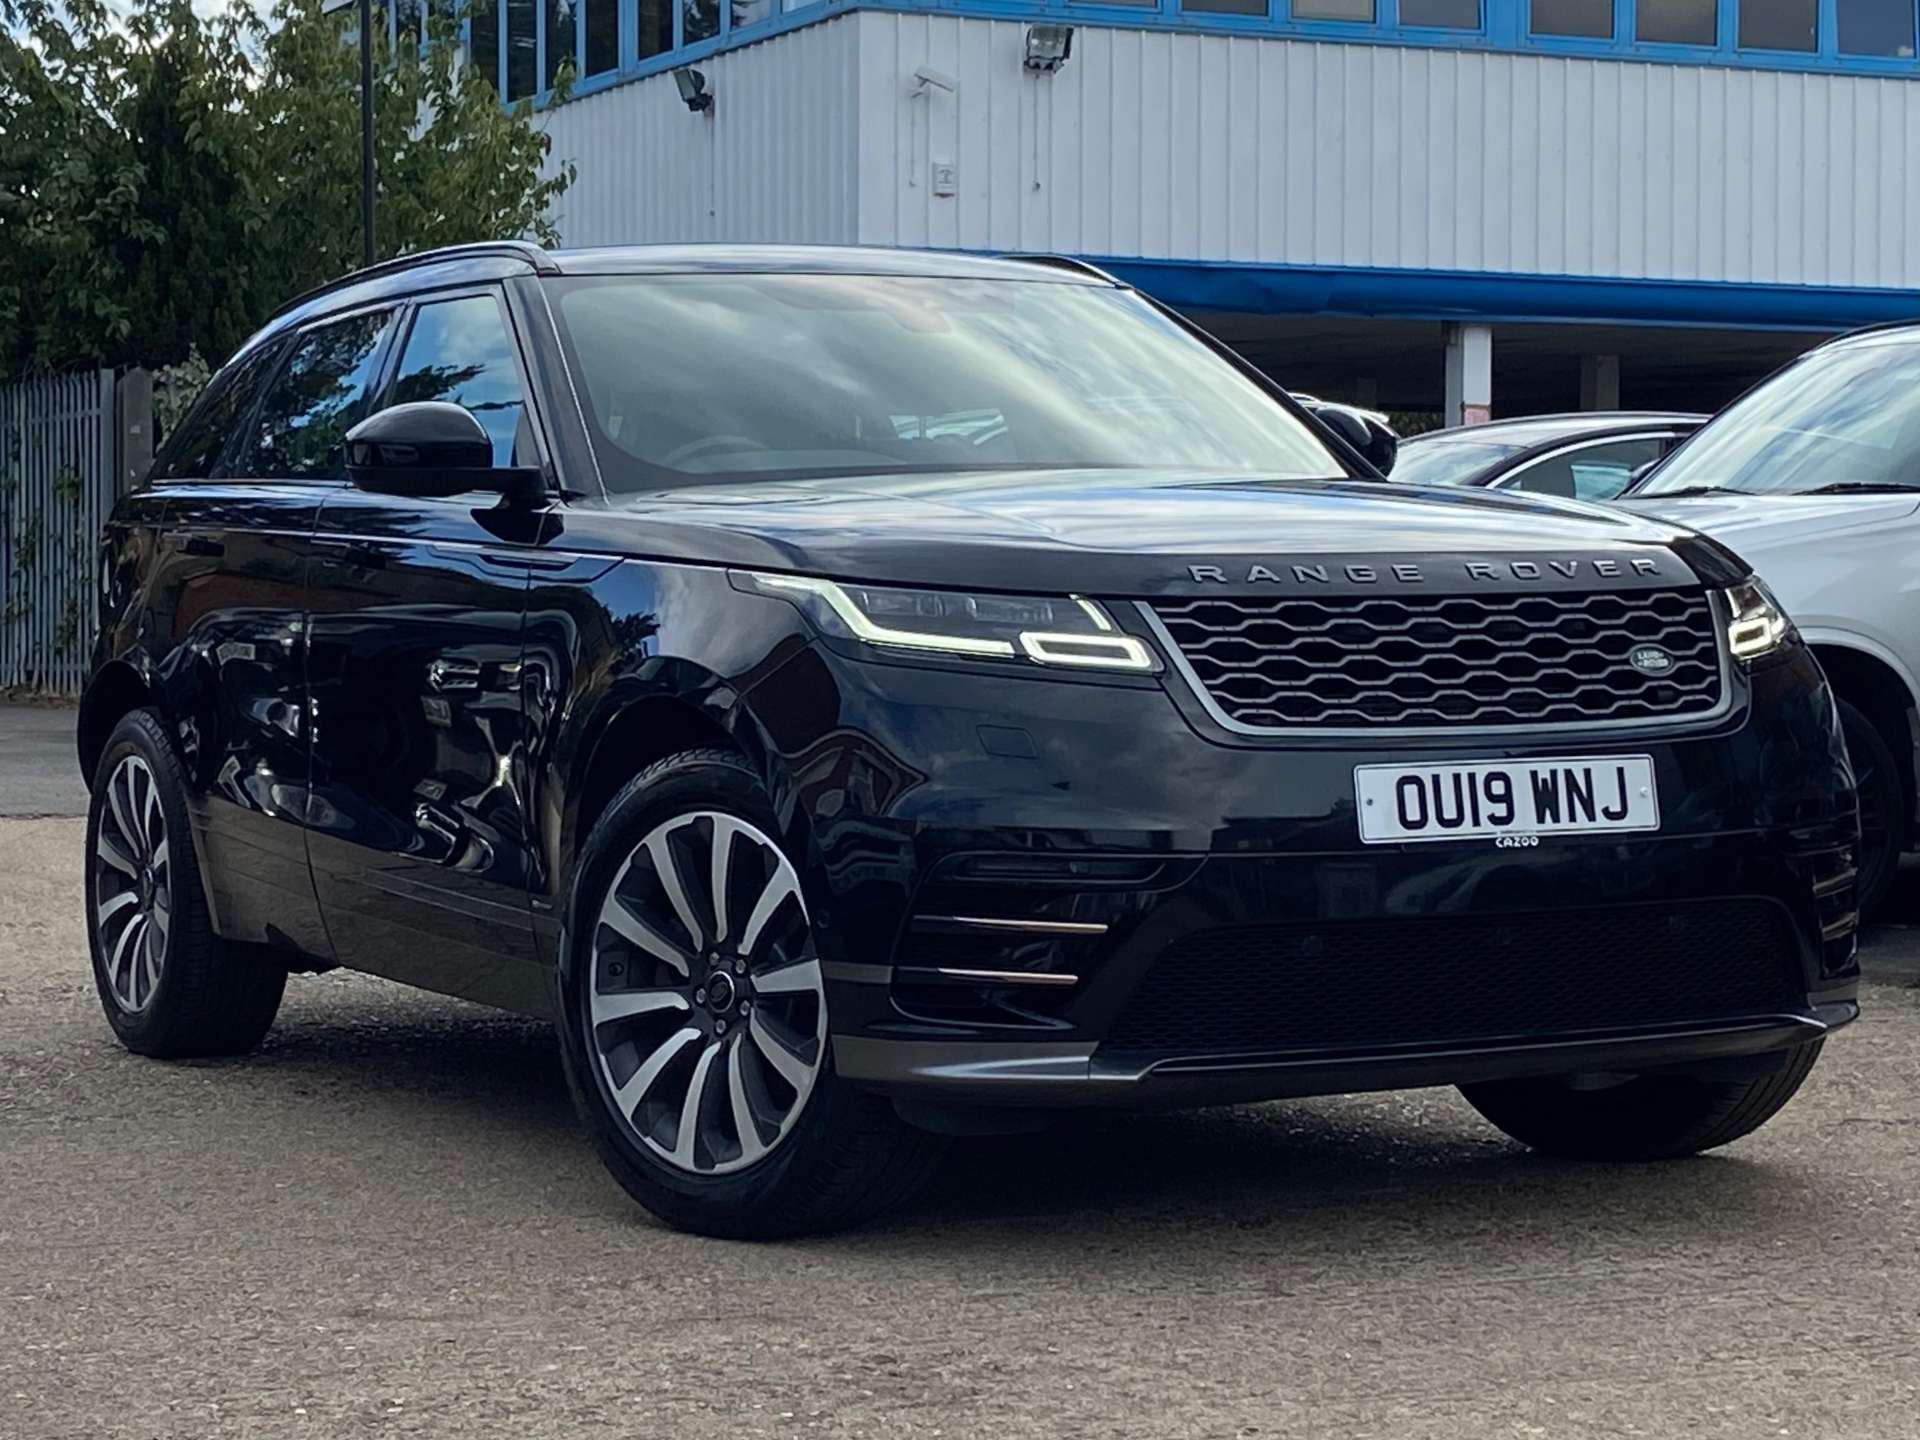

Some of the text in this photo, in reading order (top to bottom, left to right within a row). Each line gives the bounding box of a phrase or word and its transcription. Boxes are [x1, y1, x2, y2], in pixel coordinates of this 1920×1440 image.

[1188, 558, 1661, 583] RANGE ROVER
[1396, 767, 1628, 830] OU19 WNJ
